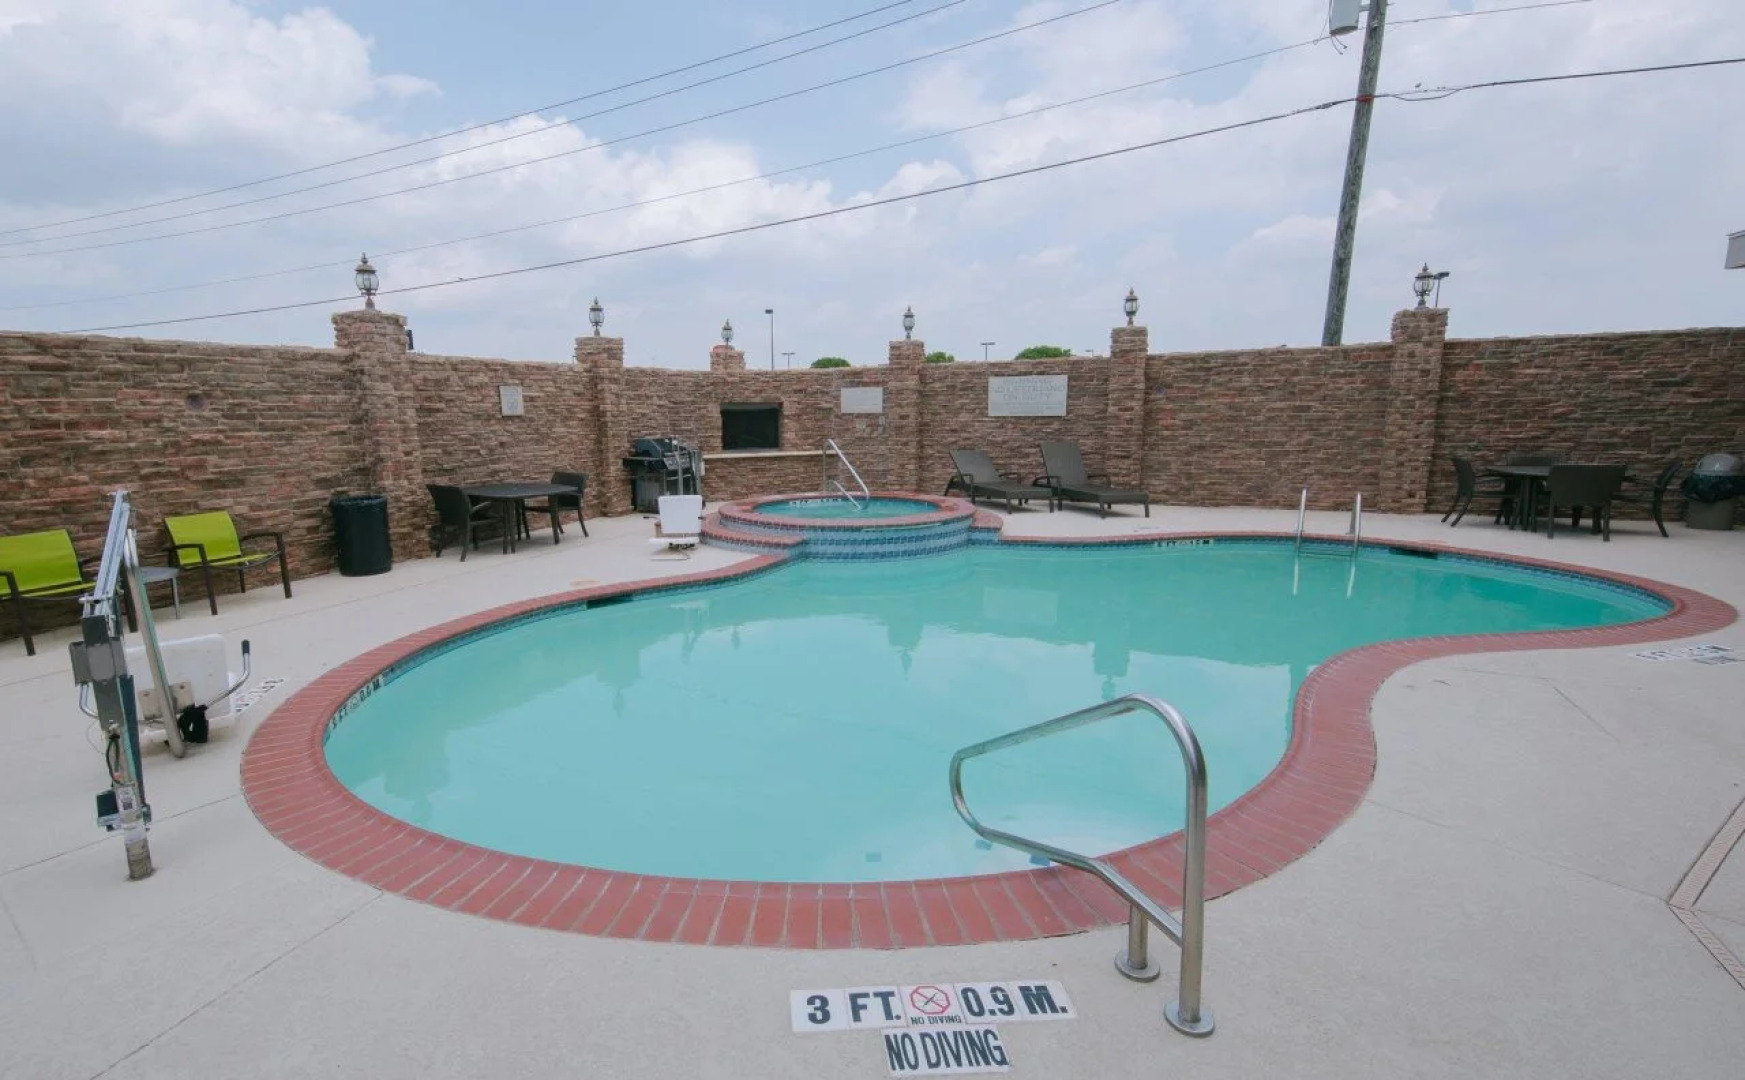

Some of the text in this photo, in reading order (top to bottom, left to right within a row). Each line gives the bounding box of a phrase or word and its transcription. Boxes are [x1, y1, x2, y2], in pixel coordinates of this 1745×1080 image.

[806, 985, 1069, 1024] 3 FT. 0.9 M.
[910, 1014, 963, 1025] NO DIVING
[884, 1028, 1010, 1071] NO DIVING
